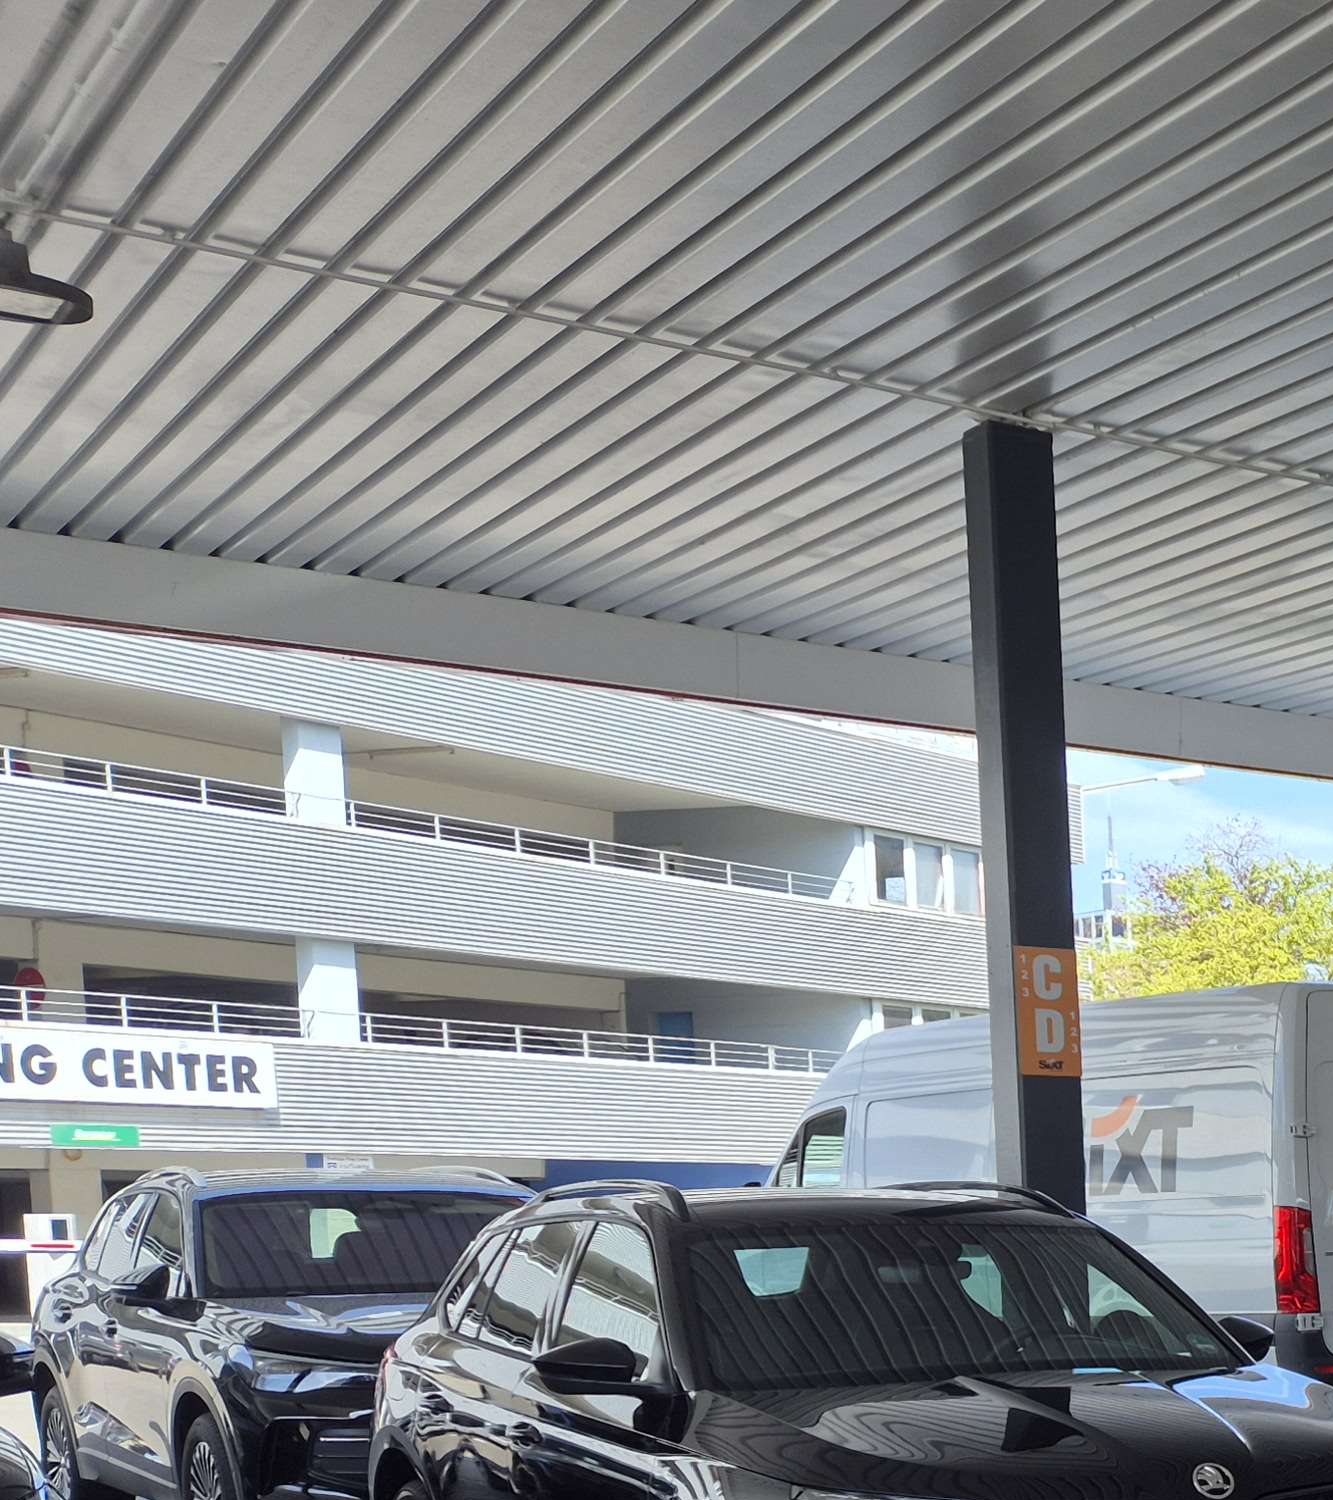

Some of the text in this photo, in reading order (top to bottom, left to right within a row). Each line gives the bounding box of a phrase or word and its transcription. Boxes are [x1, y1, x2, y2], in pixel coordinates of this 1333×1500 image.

[1033, 954, 1062, 1000] C
[1035, 1007, 1065, 1053] D
[82, 1047, 261, 1095] CENTER
[1088, 1093, 1194, 1197] IXT
